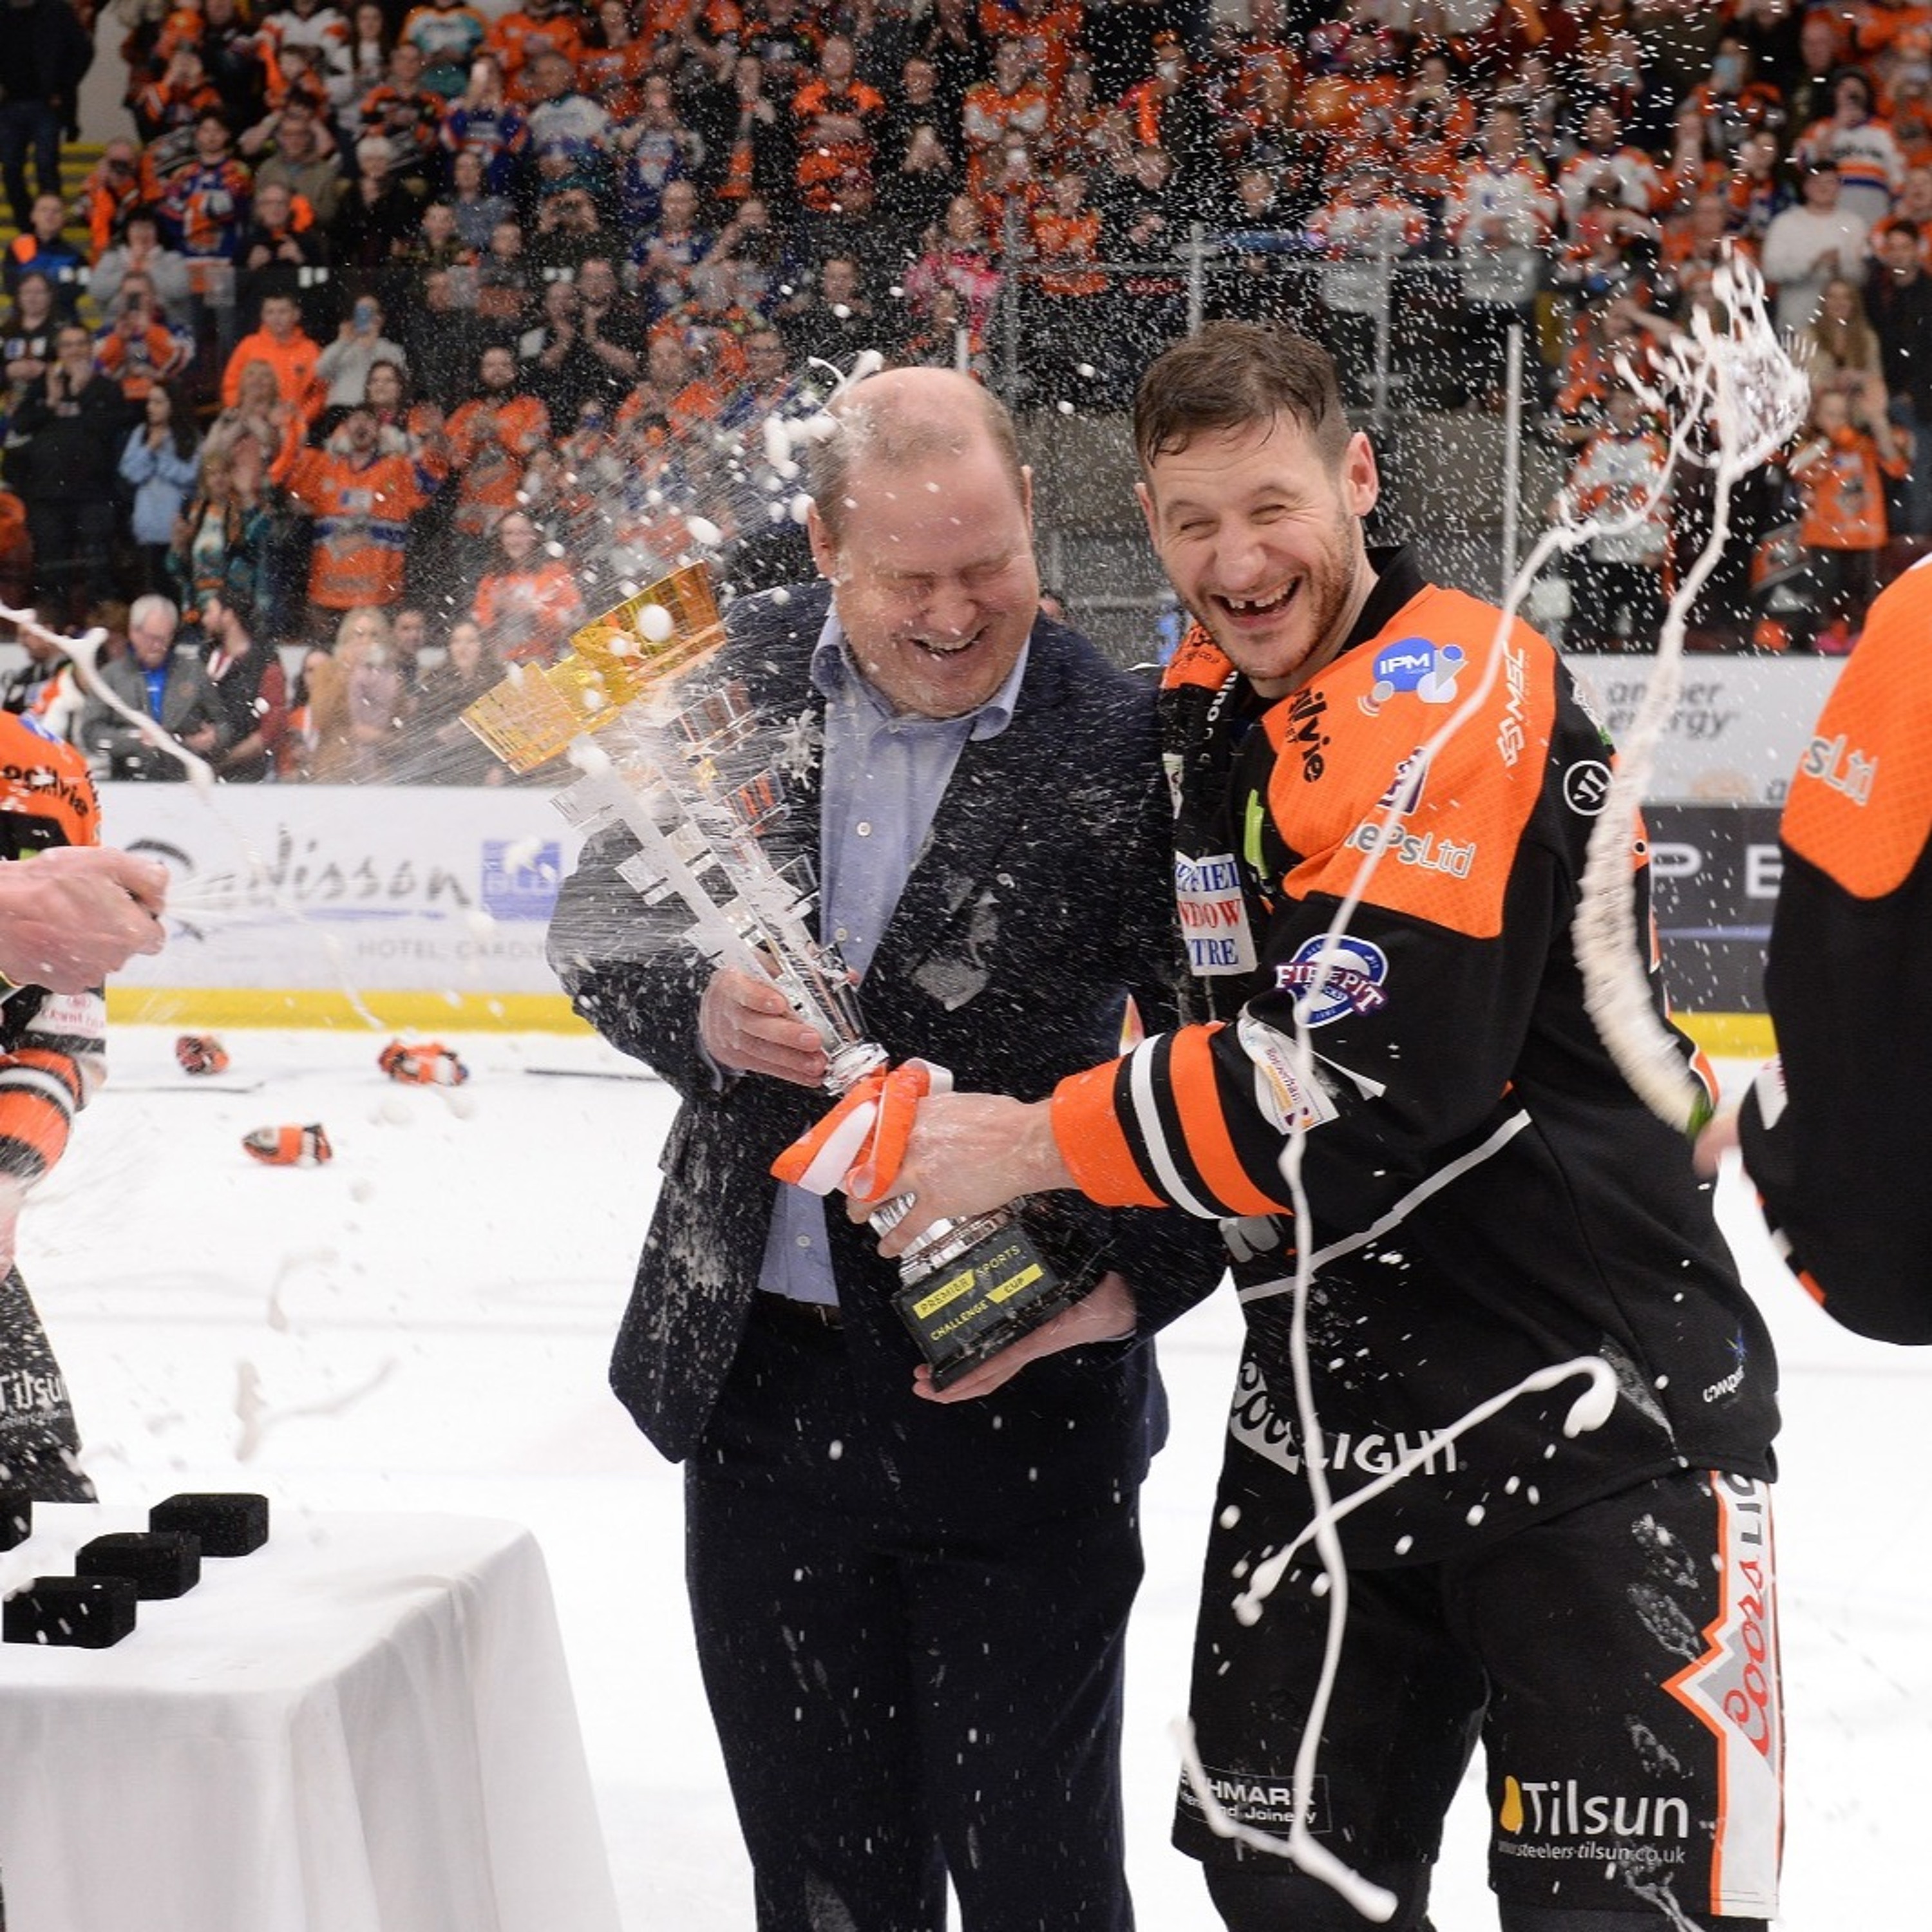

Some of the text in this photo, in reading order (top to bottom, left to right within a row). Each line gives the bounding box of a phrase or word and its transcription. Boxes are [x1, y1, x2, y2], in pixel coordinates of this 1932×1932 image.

[1379, 652, 1431, 675] IPM
[1606, 682, 1723, 705] amer
[920, 1245, 1021, 1314] PREMIER SPORTS
[931, 1276, 1025, 1341] CHALLENGE CUP
[1307, 1428, 1457, 1476] IGHT
[1723, 1555, 1769, 1757] Coors
[1245, 1806, 1316, 1824] Joiney
[1521, 1779, 1689, 1839] Tilsun
